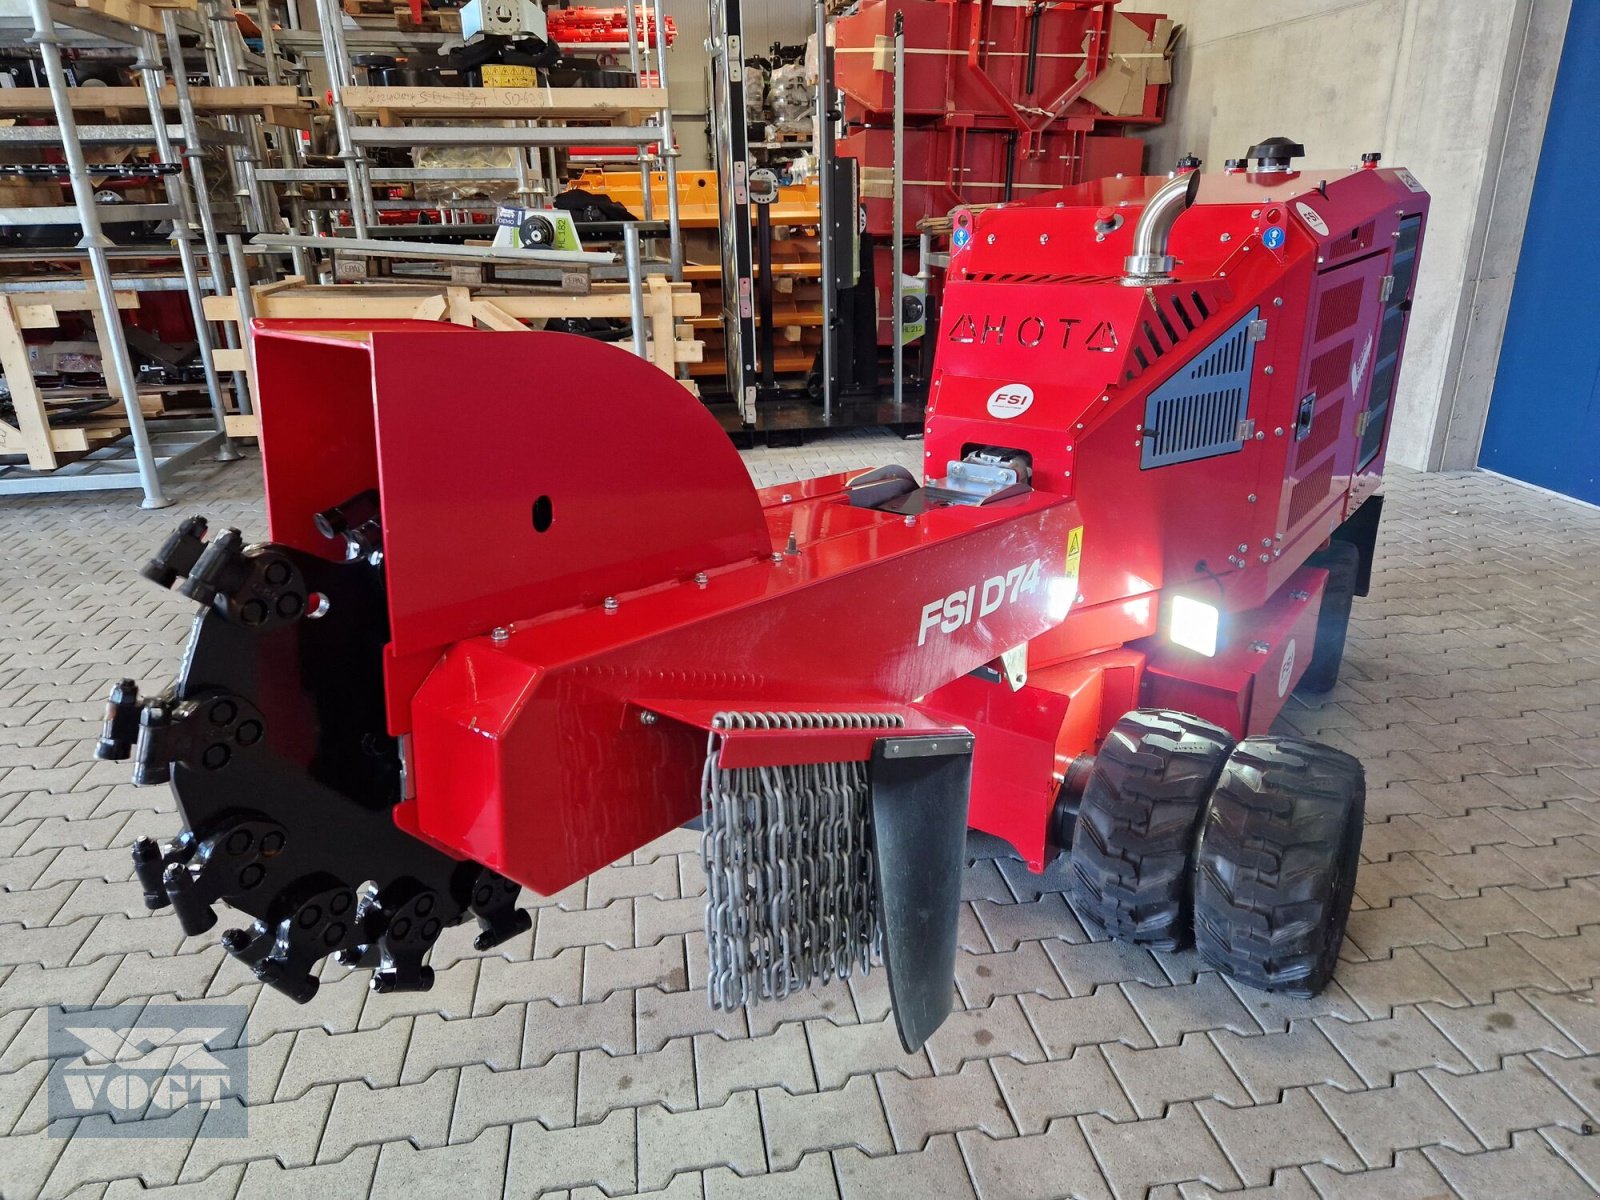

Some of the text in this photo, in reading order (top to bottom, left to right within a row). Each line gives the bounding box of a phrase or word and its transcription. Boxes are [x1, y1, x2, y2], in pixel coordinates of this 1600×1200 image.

[1303, 211, 1320, 223] FSI
[557, 219, 566, 249] HL 182
[995, 393, 1027, 405] FSI
[917, 558, 1041, 646] FSI D74
